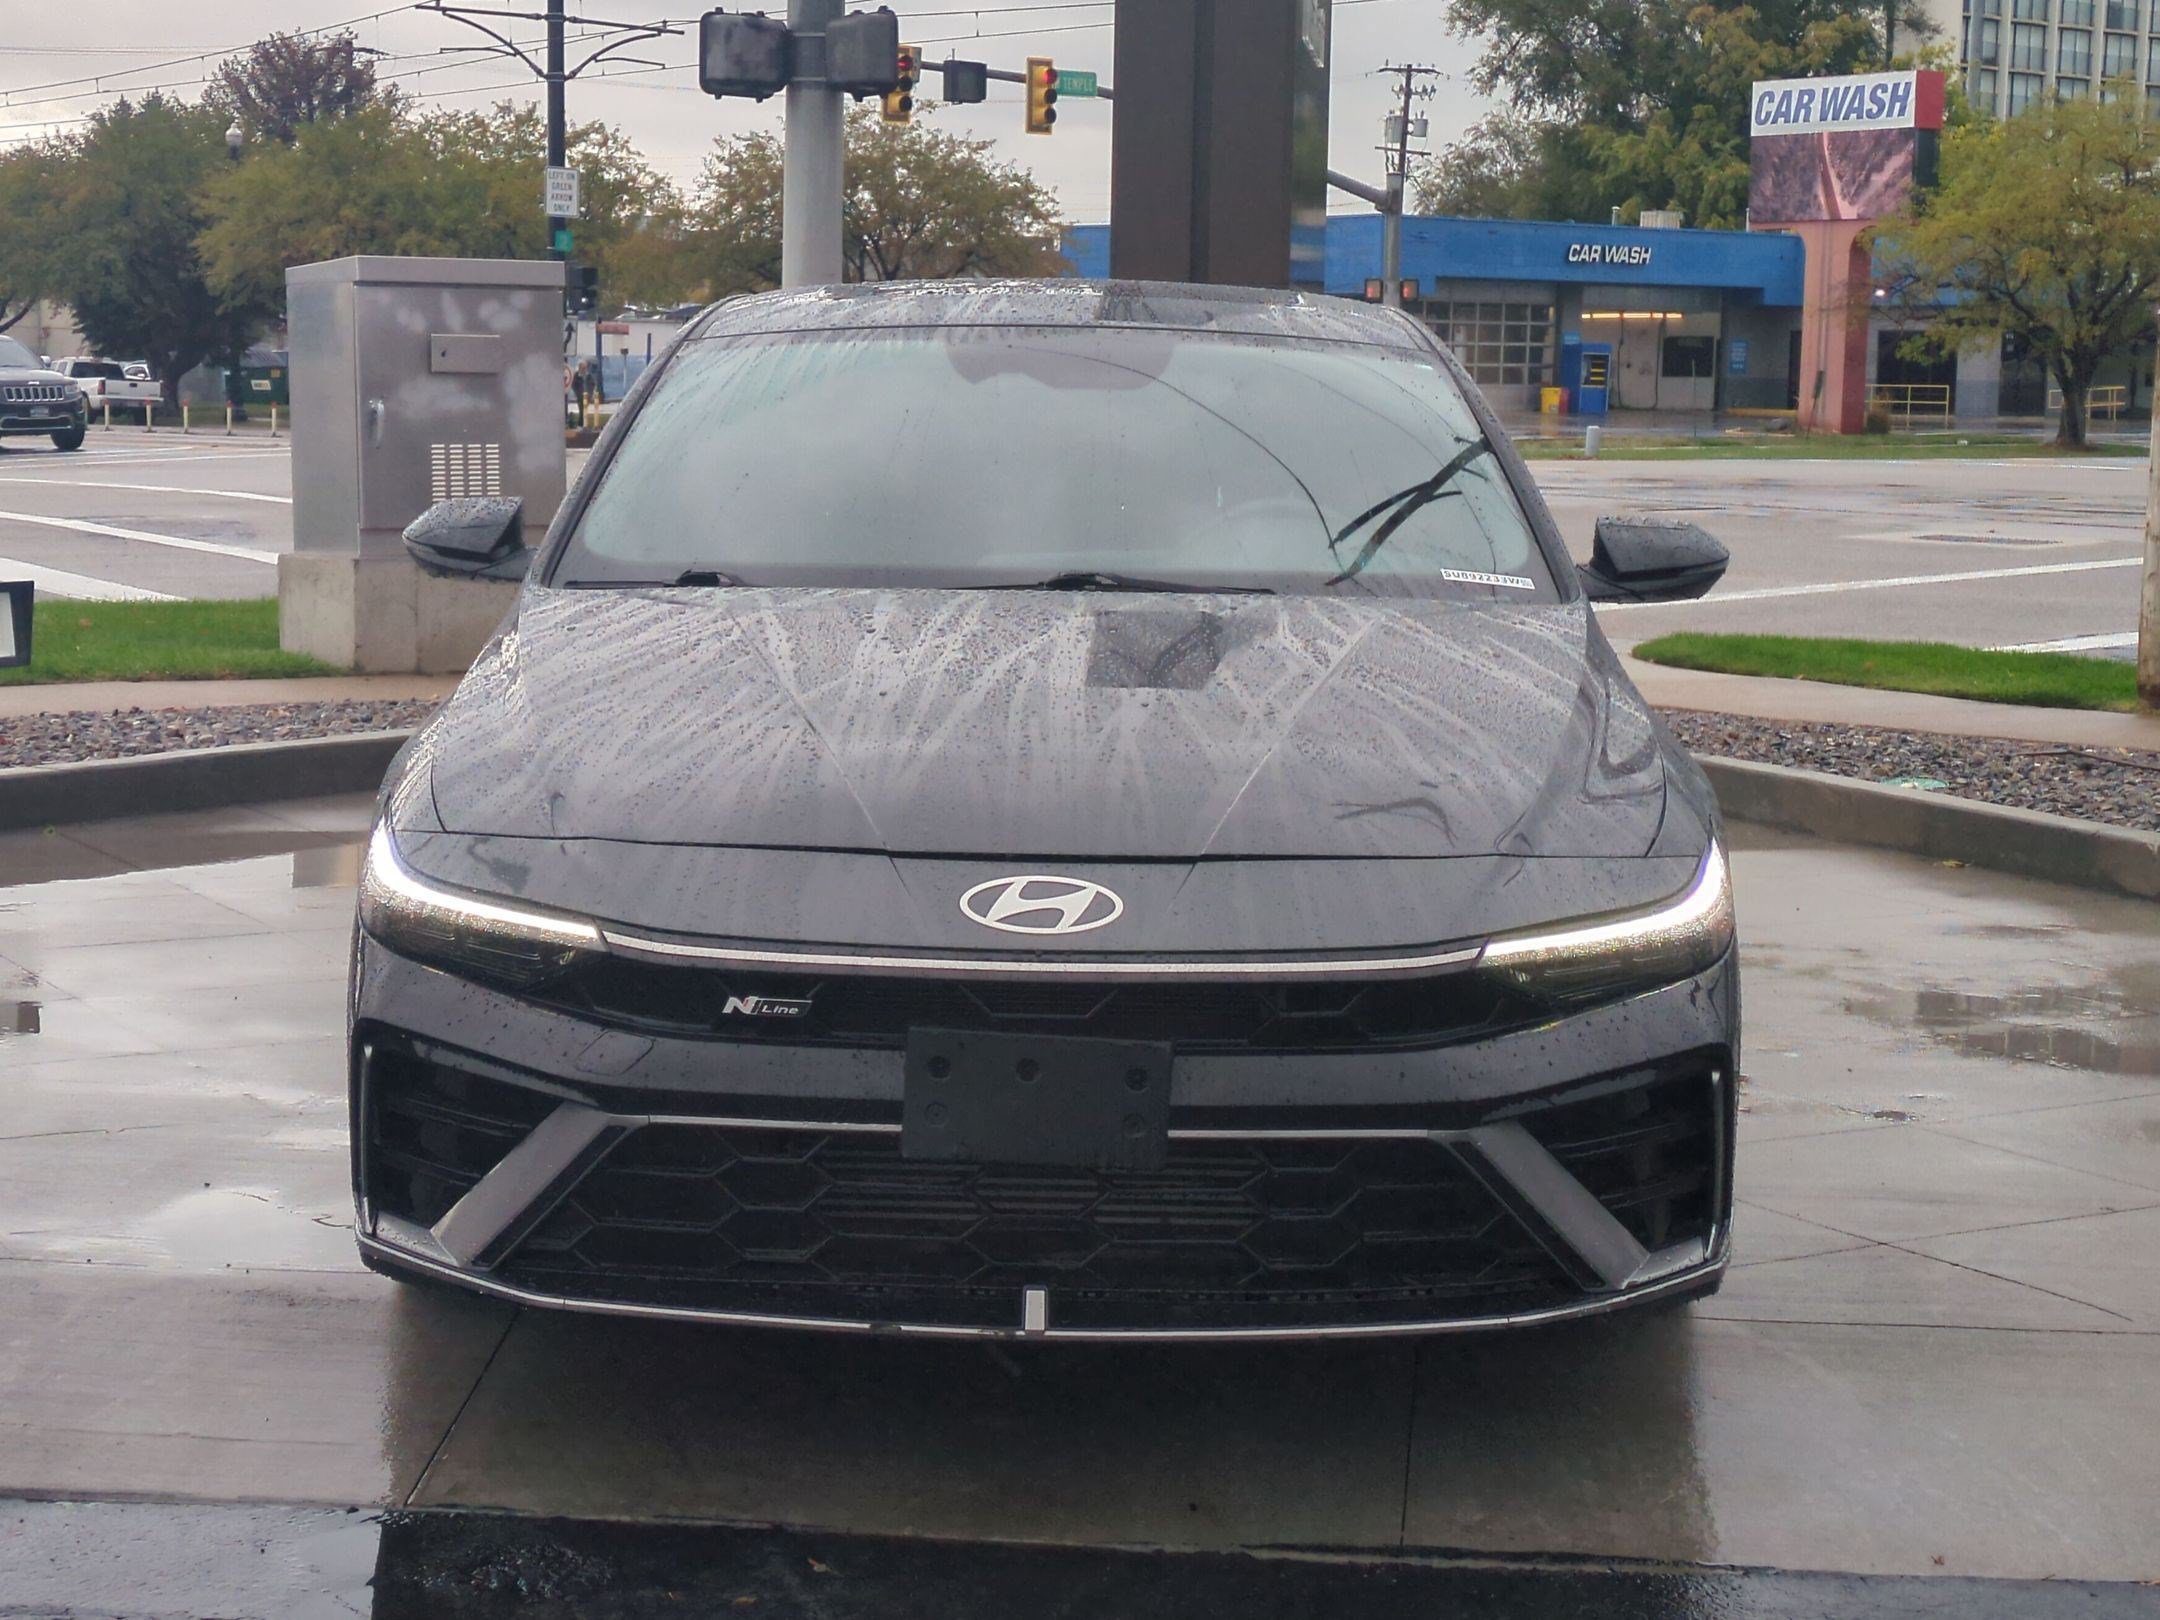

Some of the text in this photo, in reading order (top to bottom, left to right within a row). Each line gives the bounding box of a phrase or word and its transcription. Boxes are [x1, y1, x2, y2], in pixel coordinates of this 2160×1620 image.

[1063, 77, 1094, 92] TEMPLE
[1754, 81, 1912, 126] CAR WASH
[548, 170, 576, 181] LEFT ON
[551, 181, 573, 191] GREEN
[551, 192, 573, 202] ARROW
[553, 203, 571, 213] ONLY
[1568, 243, 1652, 265] CAR WASH
[761, 1004, 799, 1015] Line
